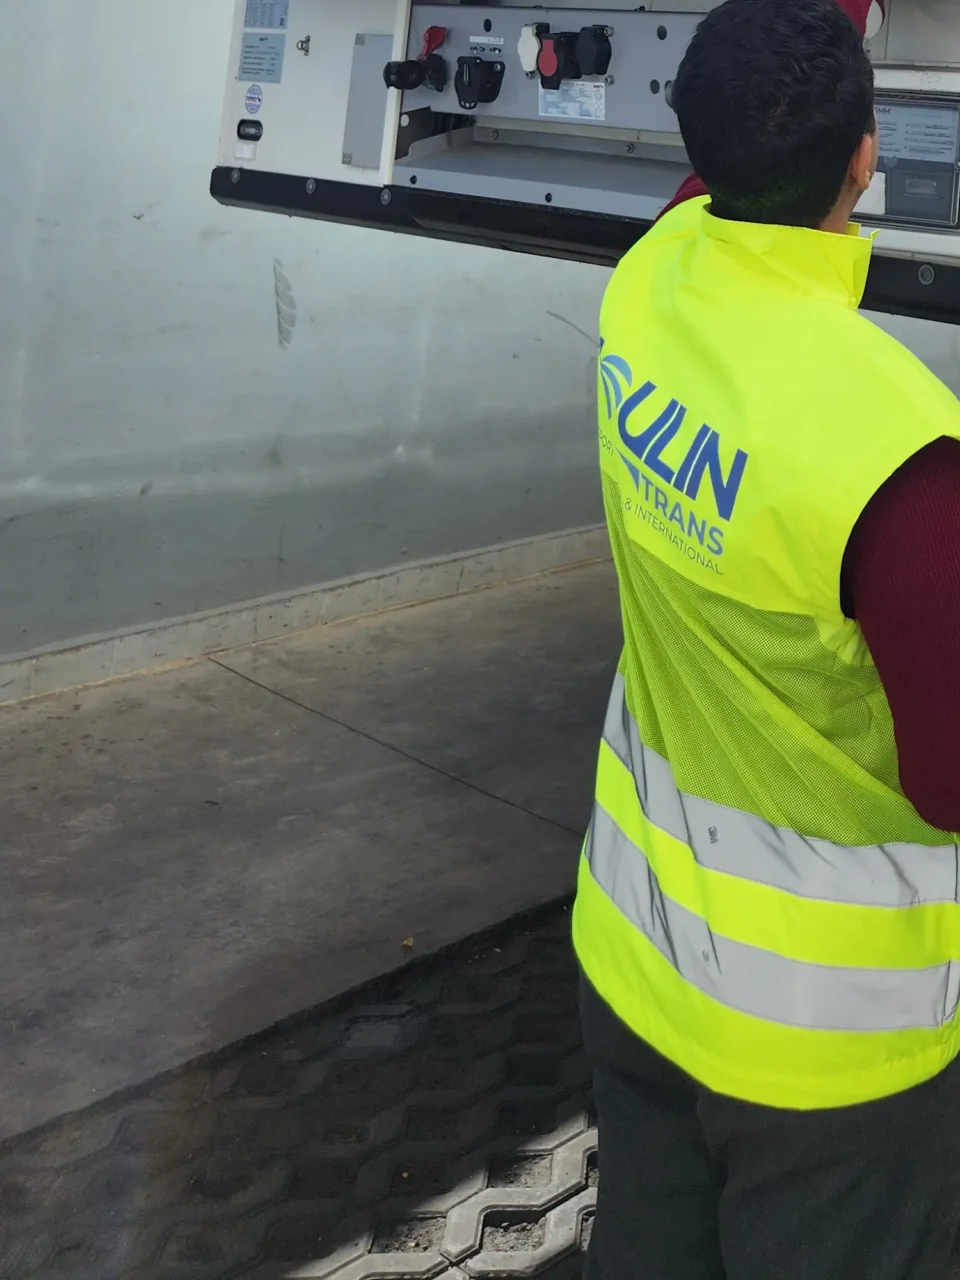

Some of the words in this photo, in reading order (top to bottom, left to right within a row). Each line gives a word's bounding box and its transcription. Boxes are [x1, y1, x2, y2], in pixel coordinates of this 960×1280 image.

[624, 497, 632, 512] &
[634, 503, 724, 576] INTERNATIONAL
[641, 472, 724, 556] TRANS
